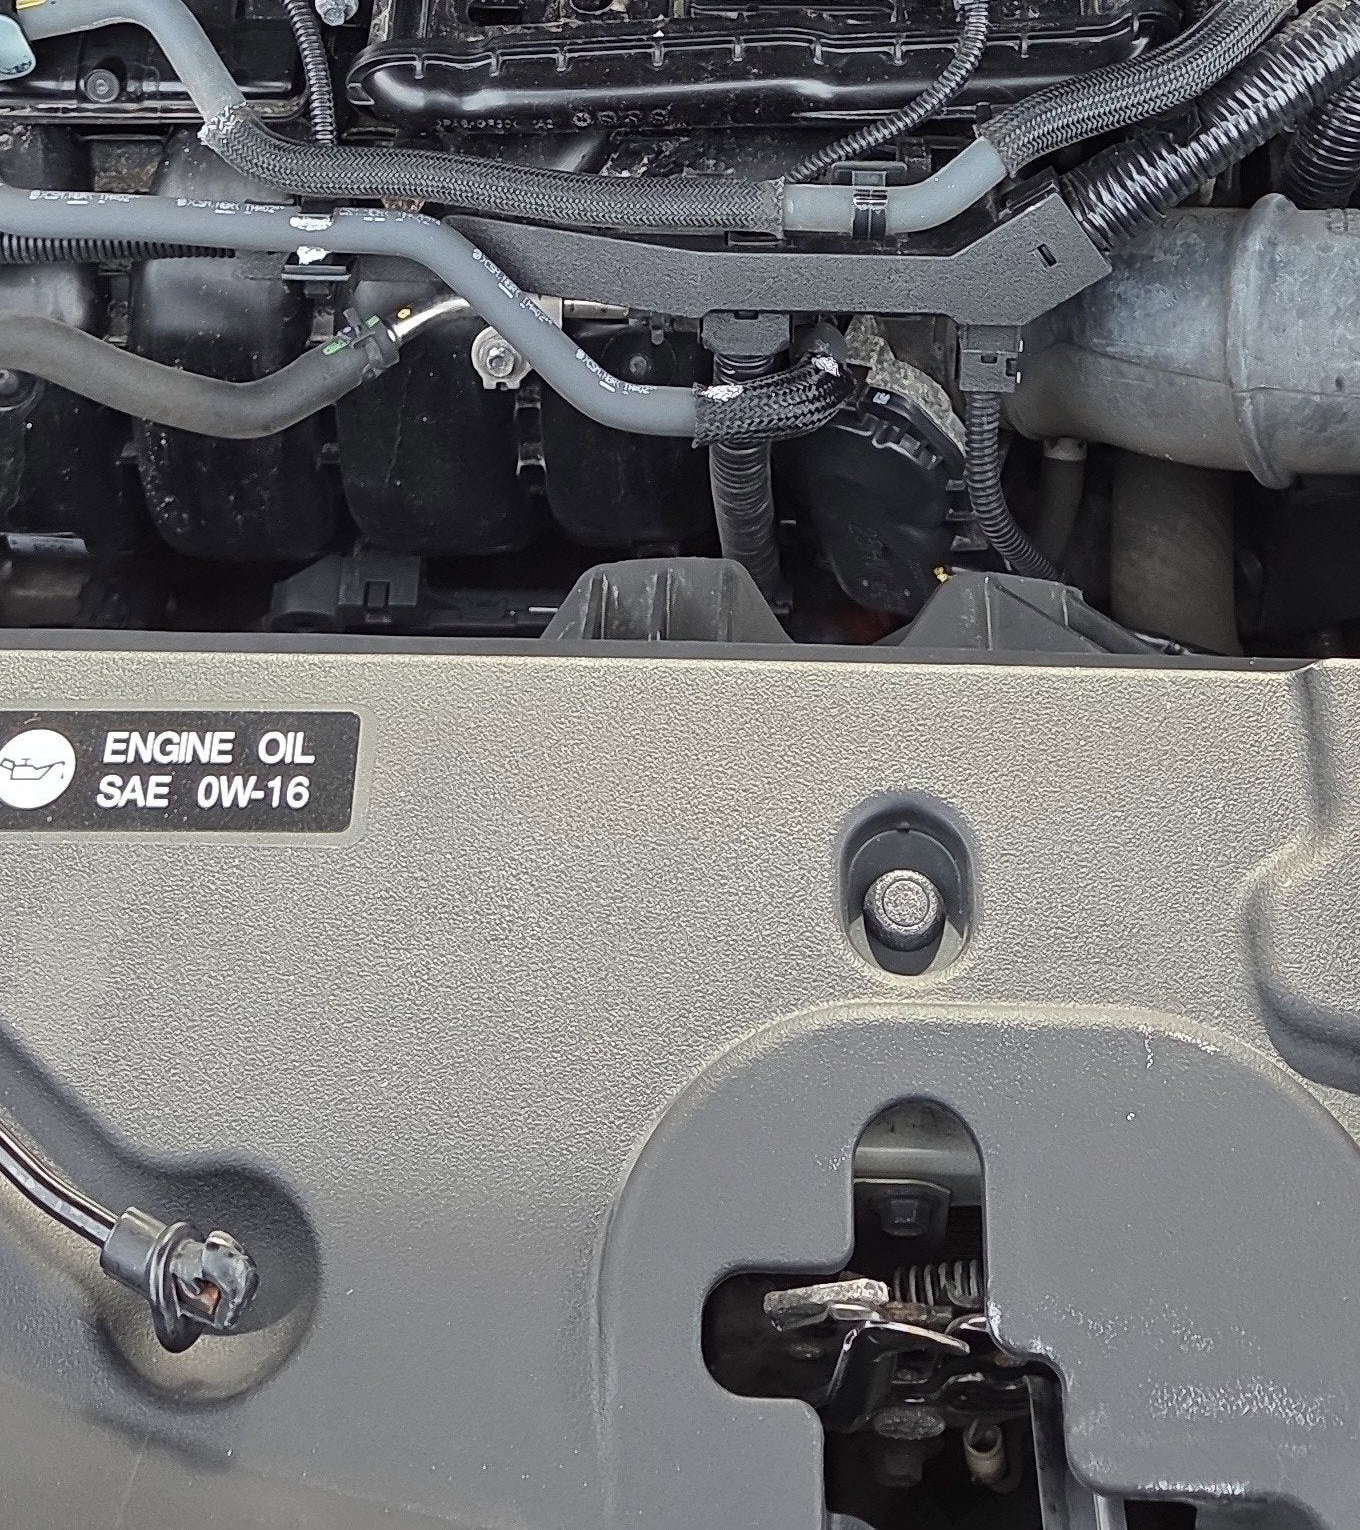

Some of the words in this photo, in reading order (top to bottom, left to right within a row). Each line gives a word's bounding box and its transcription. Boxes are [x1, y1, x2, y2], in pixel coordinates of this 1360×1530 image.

[102, 730, 236, 765] ENGINE
[257, 730, 316, 765] OIL
[96, 774, 173, 809] SAE
[197, 774, 310, 810] 0W-16
